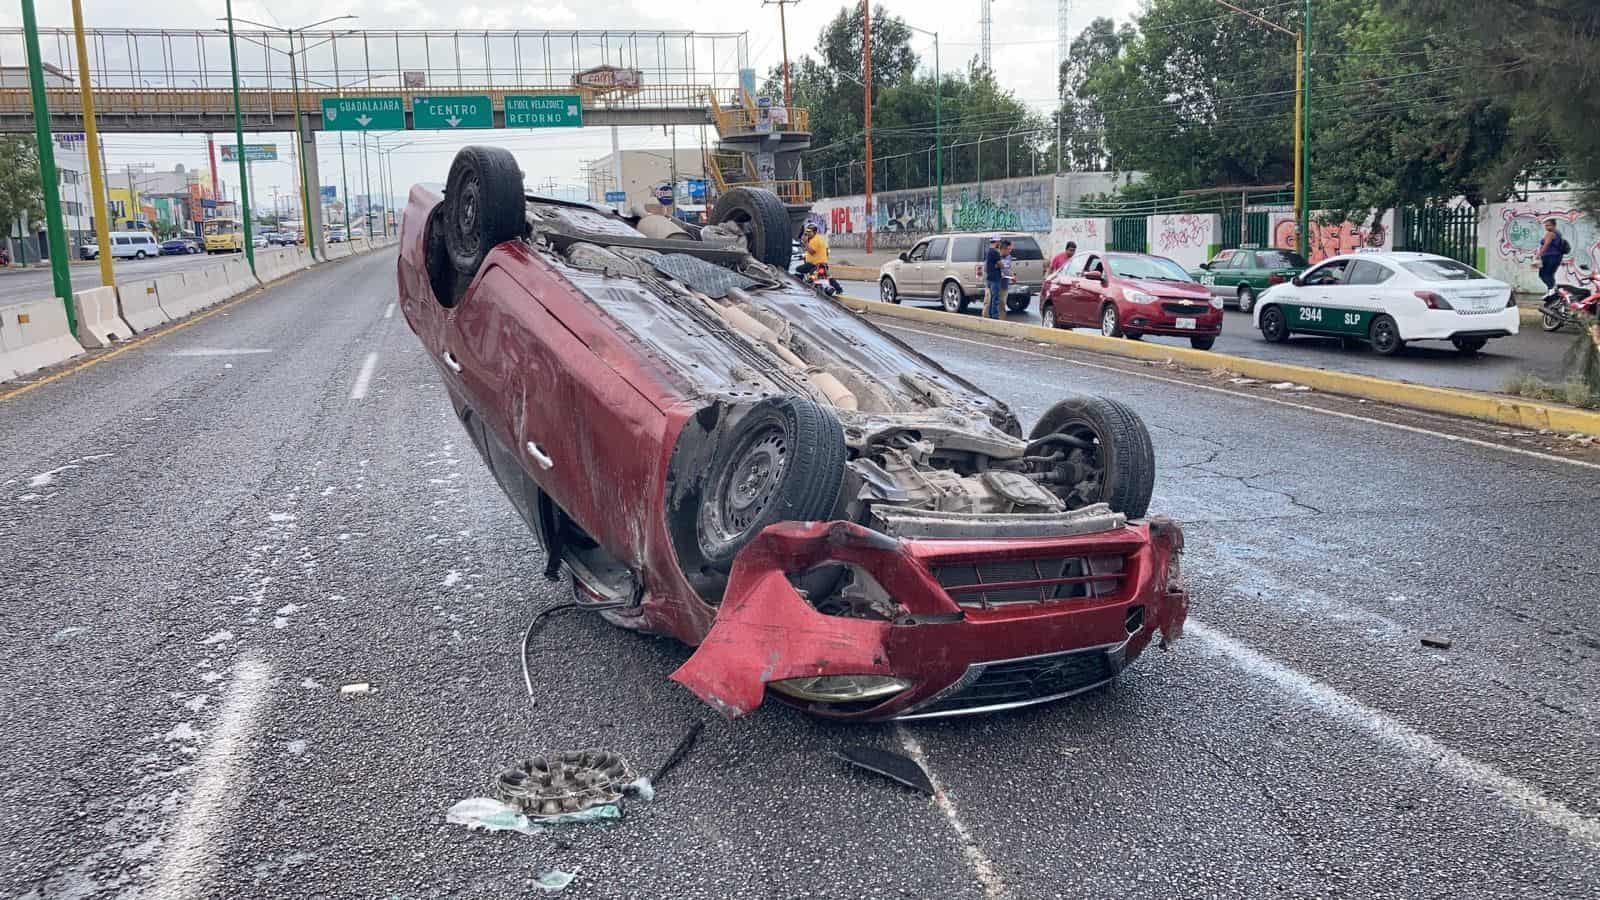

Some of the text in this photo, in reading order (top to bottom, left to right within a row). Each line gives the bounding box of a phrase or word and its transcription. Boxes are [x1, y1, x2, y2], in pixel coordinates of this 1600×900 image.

[339, 100, 400, 112] GUADALAJARA
[429, 104, 477, 116] CENTRO
[510, 113, 562, 123] RETORNO
[1300, 306, 1361, 325] 2944 SLP
